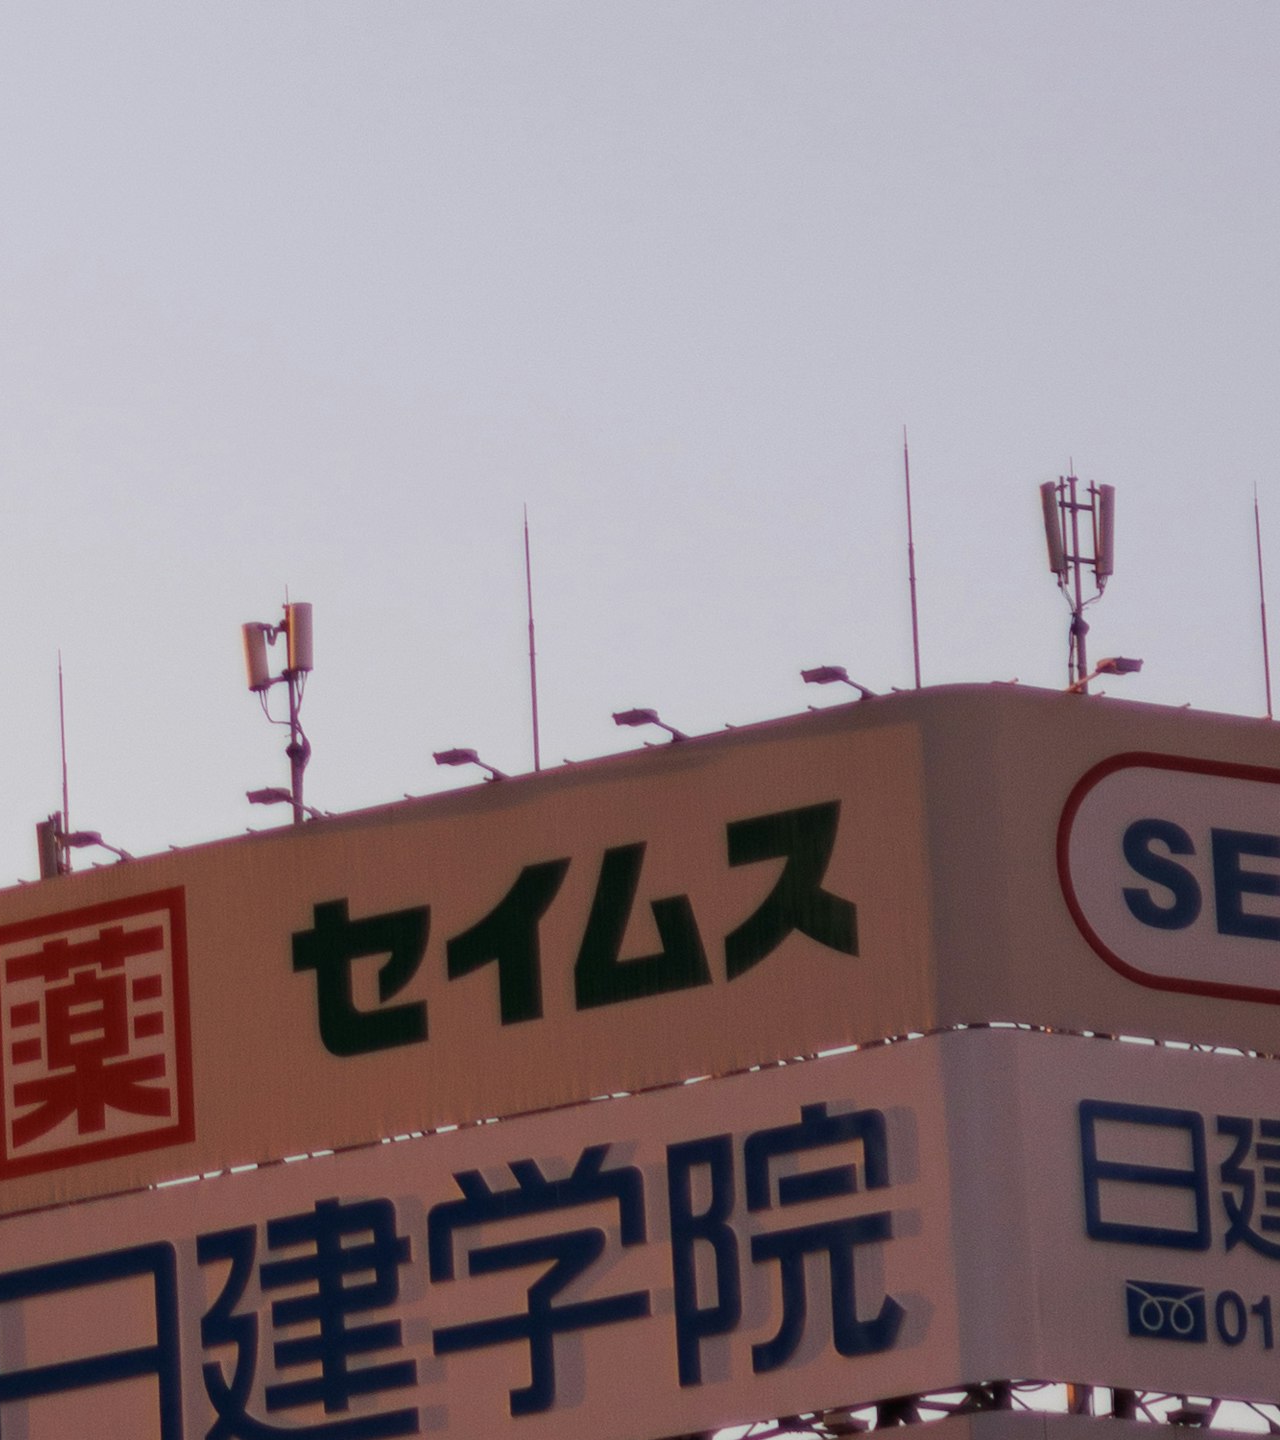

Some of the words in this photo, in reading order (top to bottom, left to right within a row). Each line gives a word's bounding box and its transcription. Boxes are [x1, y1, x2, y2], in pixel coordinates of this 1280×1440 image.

[1121, 817, 1280, 939] SE
[4, 923, 173, 1151] 薬
[291, 798, 860, 1058] セイムス
[1215, 1289, 1274, 1350] 01
